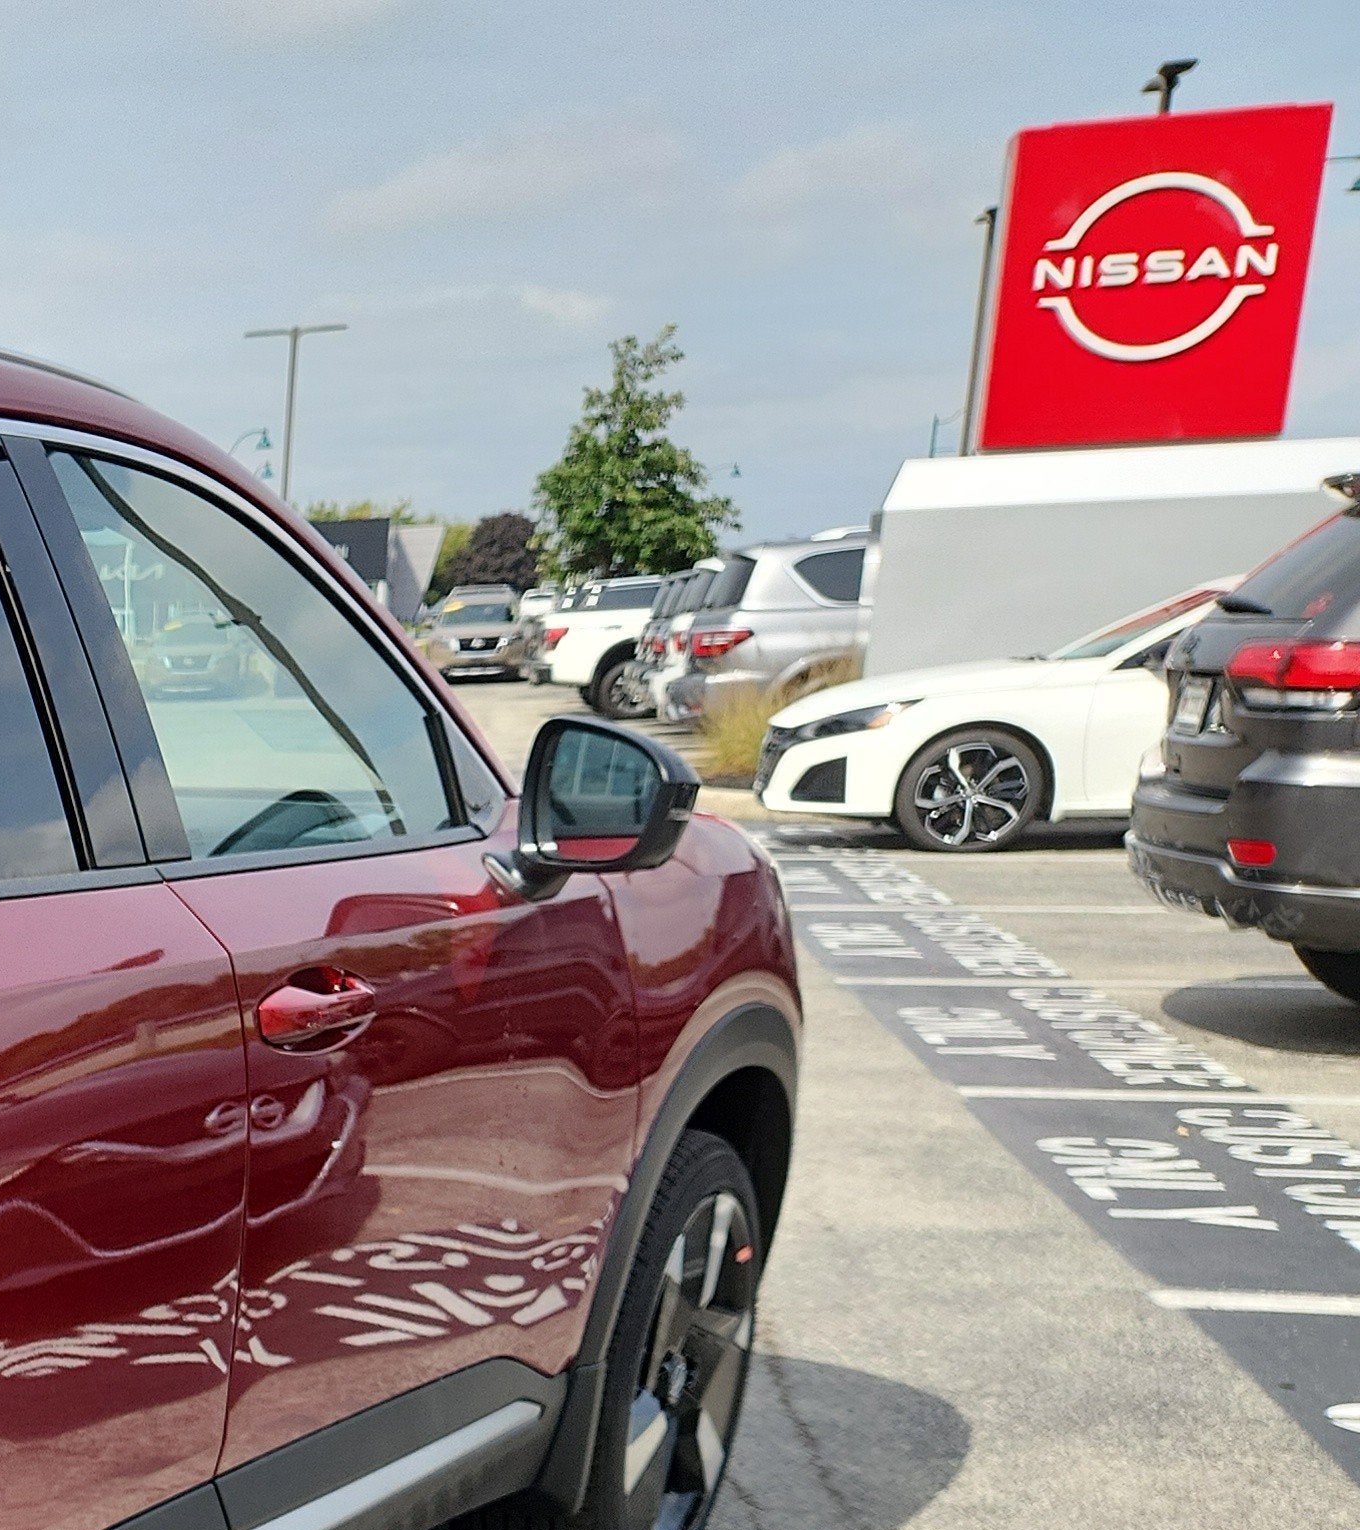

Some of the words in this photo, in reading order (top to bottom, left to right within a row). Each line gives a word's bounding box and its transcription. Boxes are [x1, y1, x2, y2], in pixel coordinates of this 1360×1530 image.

[1032, 242, 1279, 291] NISSAN
[897, 1005, 1056, 1060] ONLY
[1008, 987, 1245, 1088] CUSTOMER
[1034, 1136, 1279, 1231] ONLY
